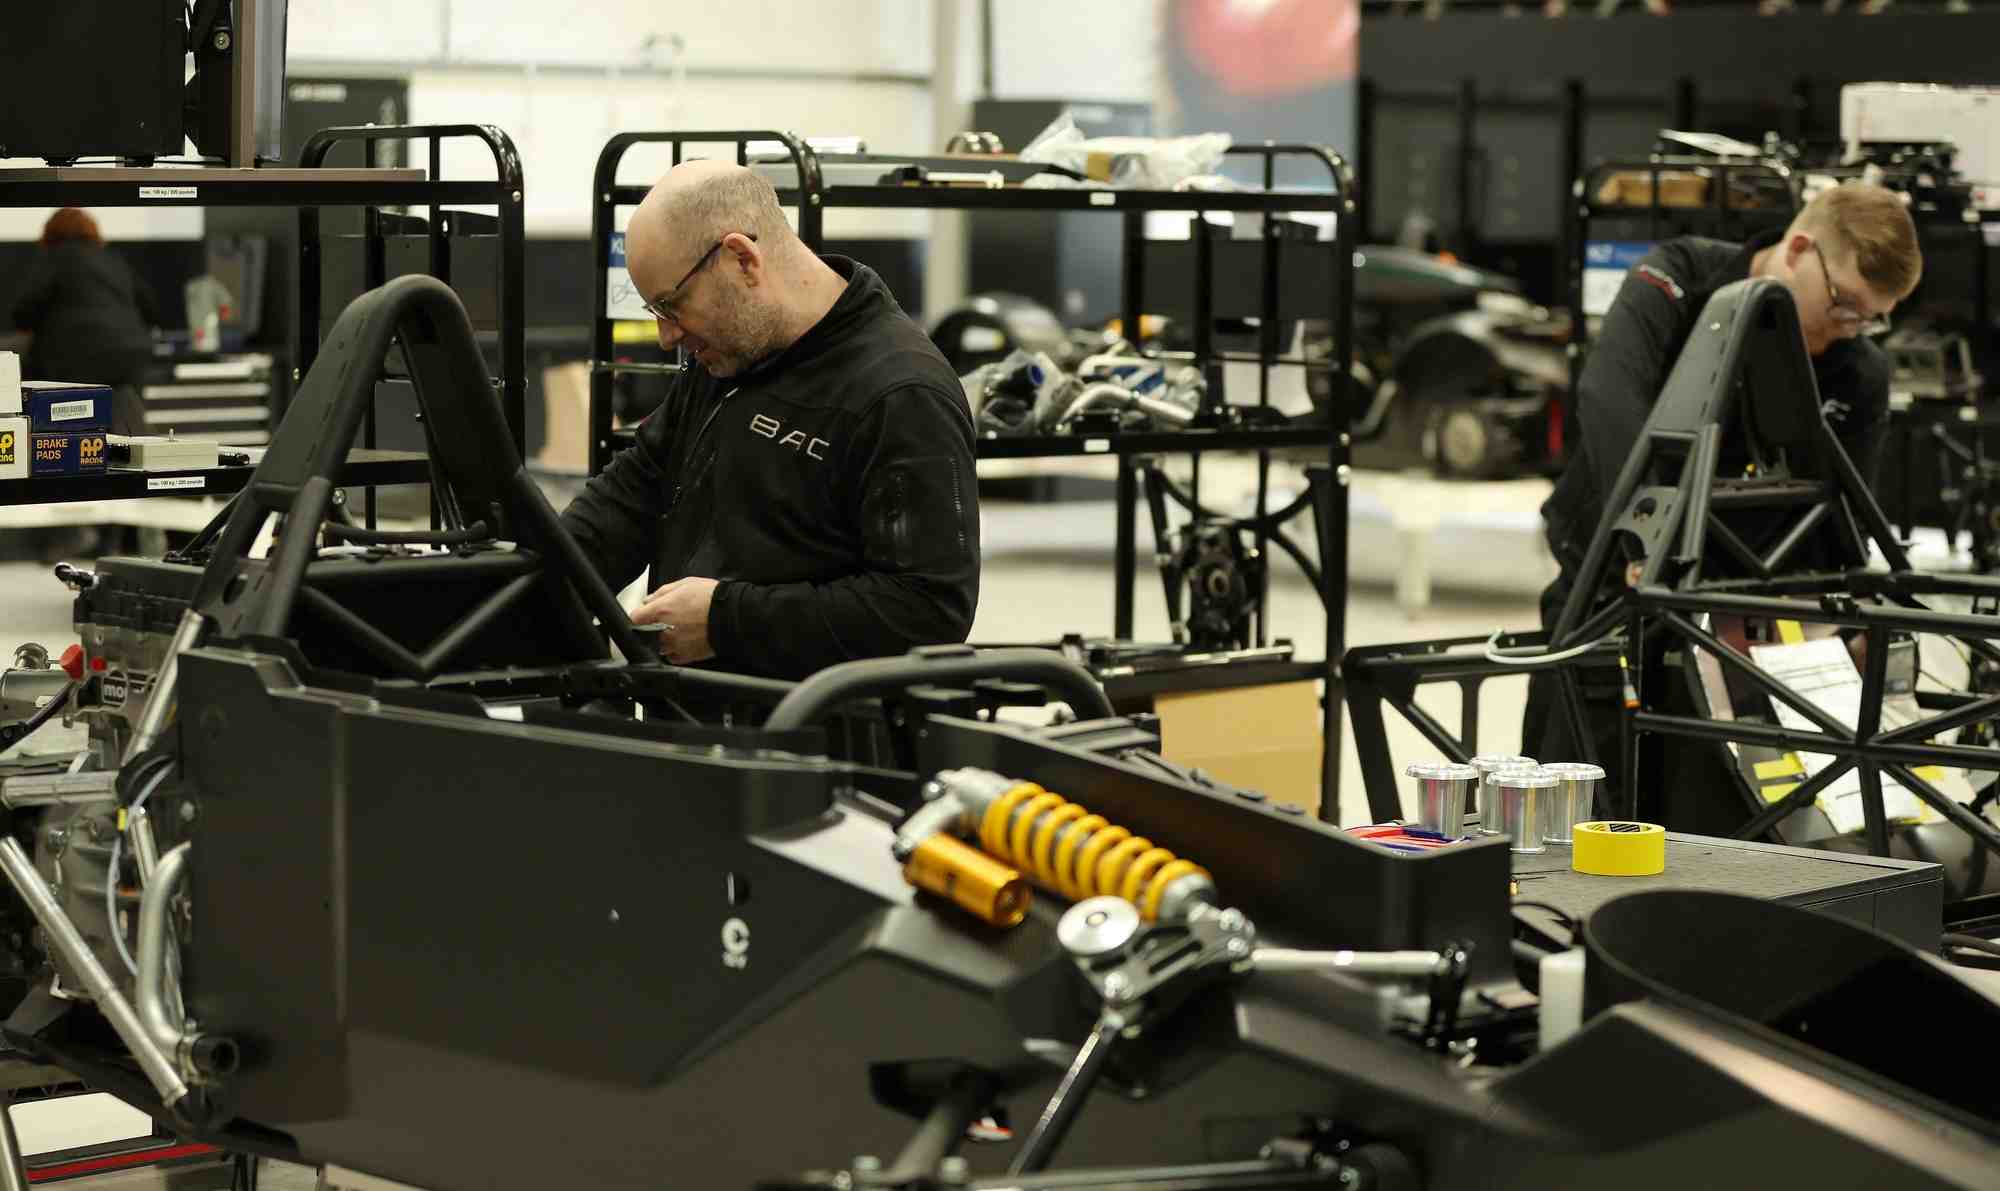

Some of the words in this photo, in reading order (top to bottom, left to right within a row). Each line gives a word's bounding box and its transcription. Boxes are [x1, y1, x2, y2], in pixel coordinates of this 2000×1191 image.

[610, 237, 625, 255] KL
[0, 433, 13, 455] P
[36, 438, 68, 449] BRAKE
[750, 414, 830, 460] BAC
[36, 450, 61, 460] PADS
[80, 438, 104, 457] AP
